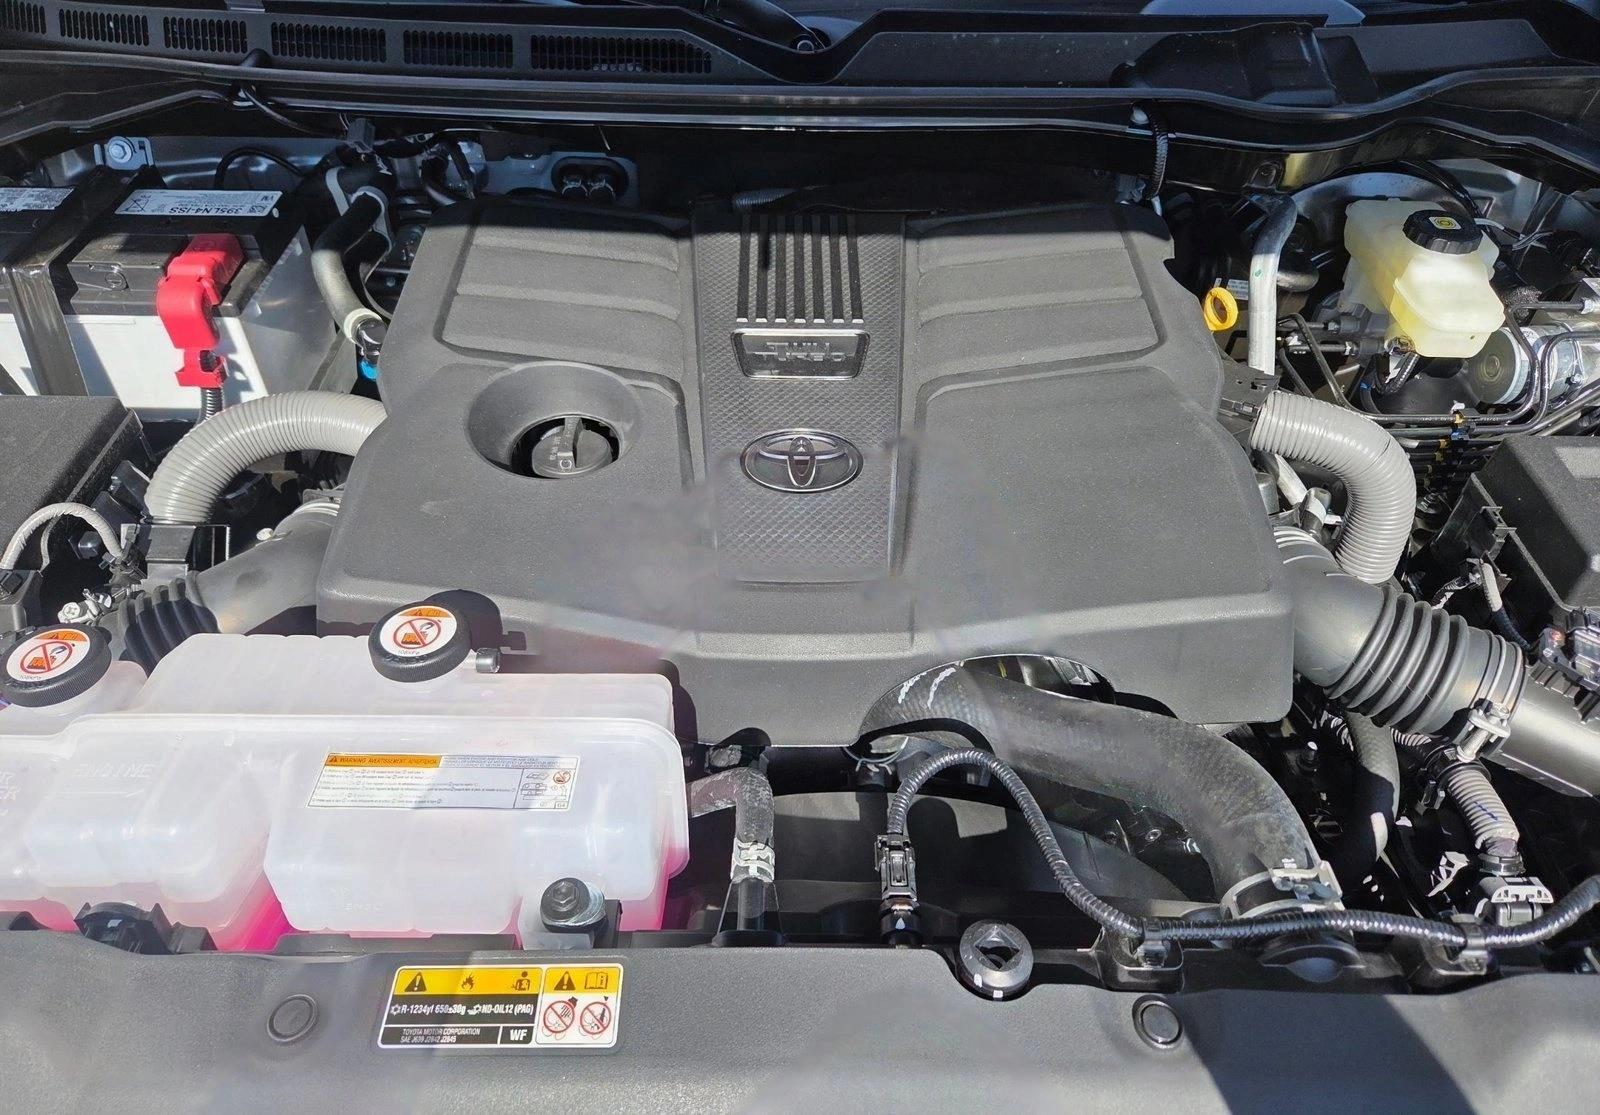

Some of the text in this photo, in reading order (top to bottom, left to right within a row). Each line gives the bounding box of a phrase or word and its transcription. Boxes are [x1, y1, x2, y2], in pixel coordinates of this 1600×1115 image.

[168, 206, 243, 214] 395LN4-ISS
[401, 1004, 434, 1015] R-1234yf
[481, 1004, 514, 1014] ND-OIL12
[514, 1004, 534, 1015] (PAG)
[400, 1035, 411, 1043] SAE
[509, 1029, 528, 1041] WF
